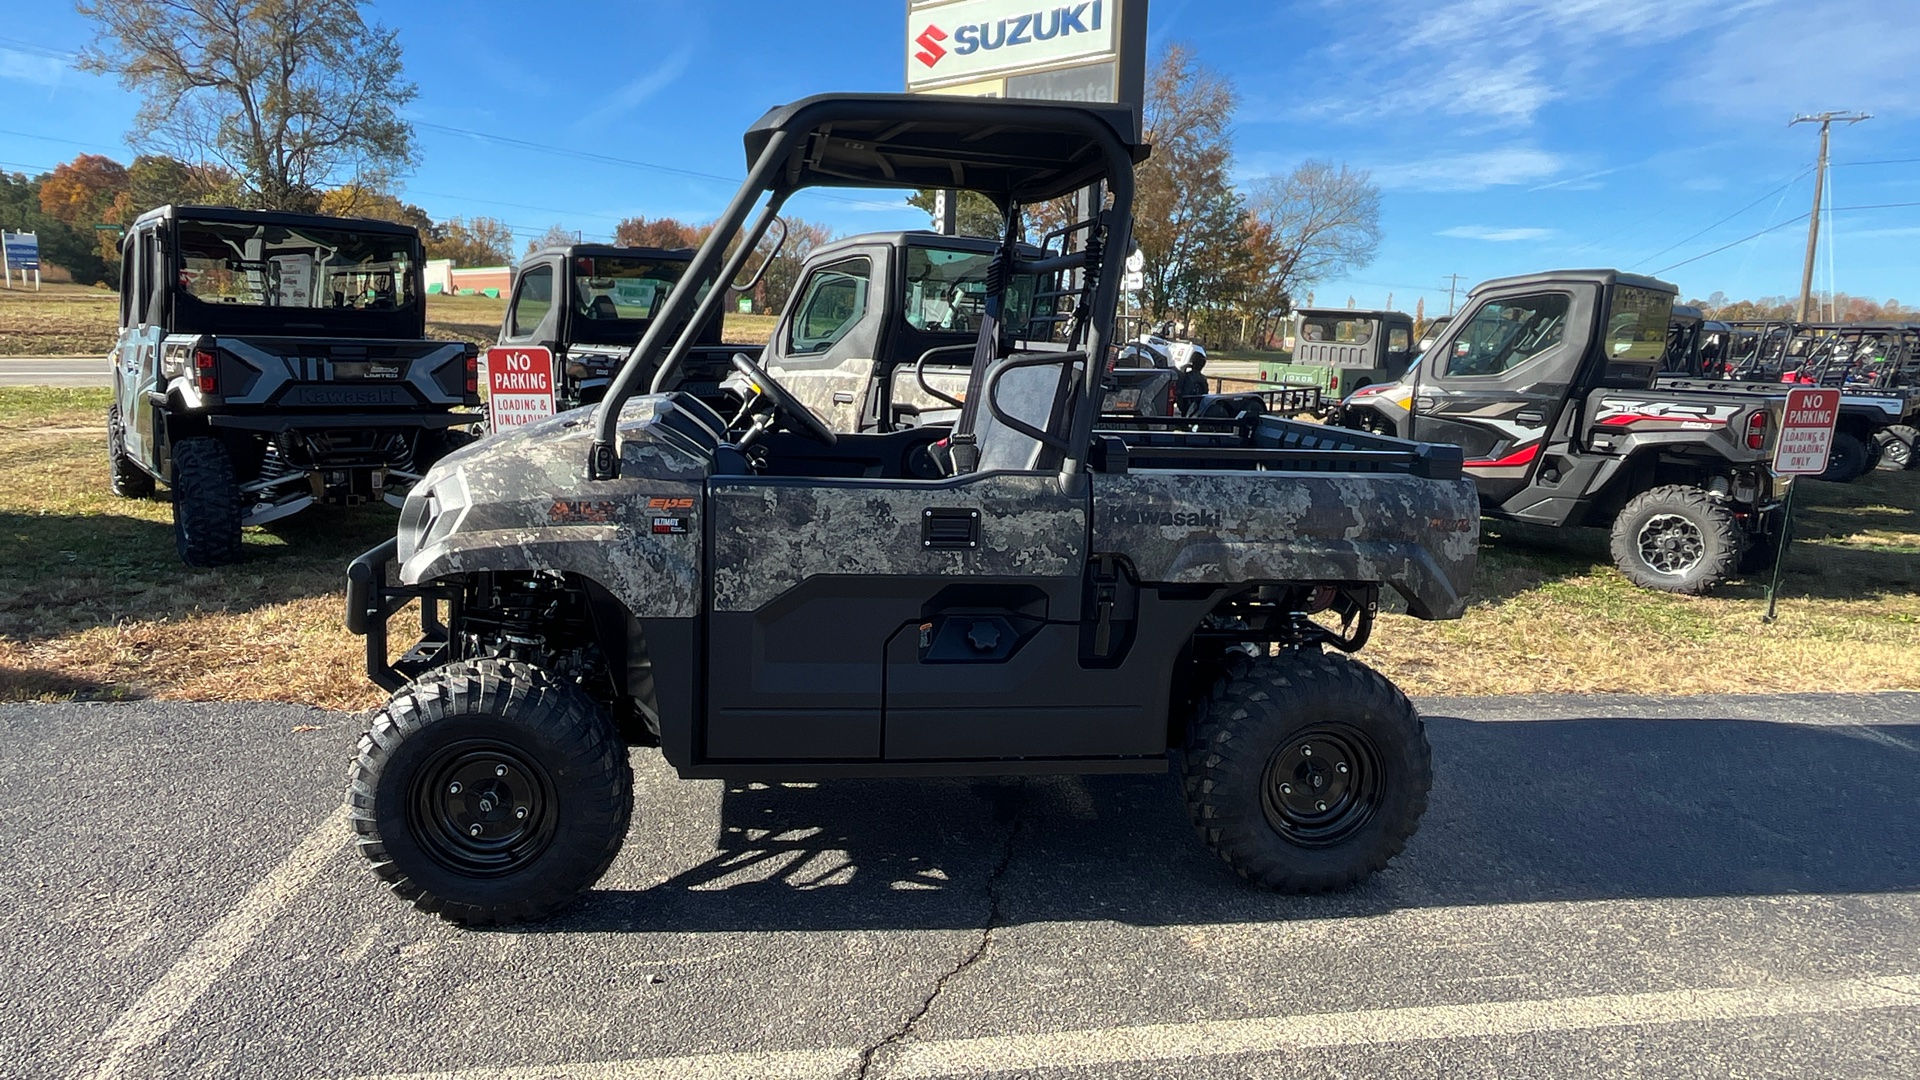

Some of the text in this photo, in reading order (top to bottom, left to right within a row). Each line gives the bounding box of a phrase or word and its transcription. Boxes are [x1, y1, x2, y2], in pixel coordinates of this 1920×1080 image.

[953, 0, 1102, 56] SUZUKI
[1016, 82, 1109, 102] imate
[506, 354, 531, 371] NO
[494, 372, 547, 390] PARKING
[300, 388, 398, 404] Kawasaki
[1802, 395, 1823, 408] NO
[497, 399, 547, 411] LOADING &
[498, 414, 549, 426] UNLOADI
[1788, 410, 1832, 424] PARKING
[1785, 431, 1826, 442] LOADING &
[1782, 444, 1825, 454] UNLOADING
[1790, 456, 1811, 466] ONLY
[1108, 507, 1221, 528] Kawasaki
